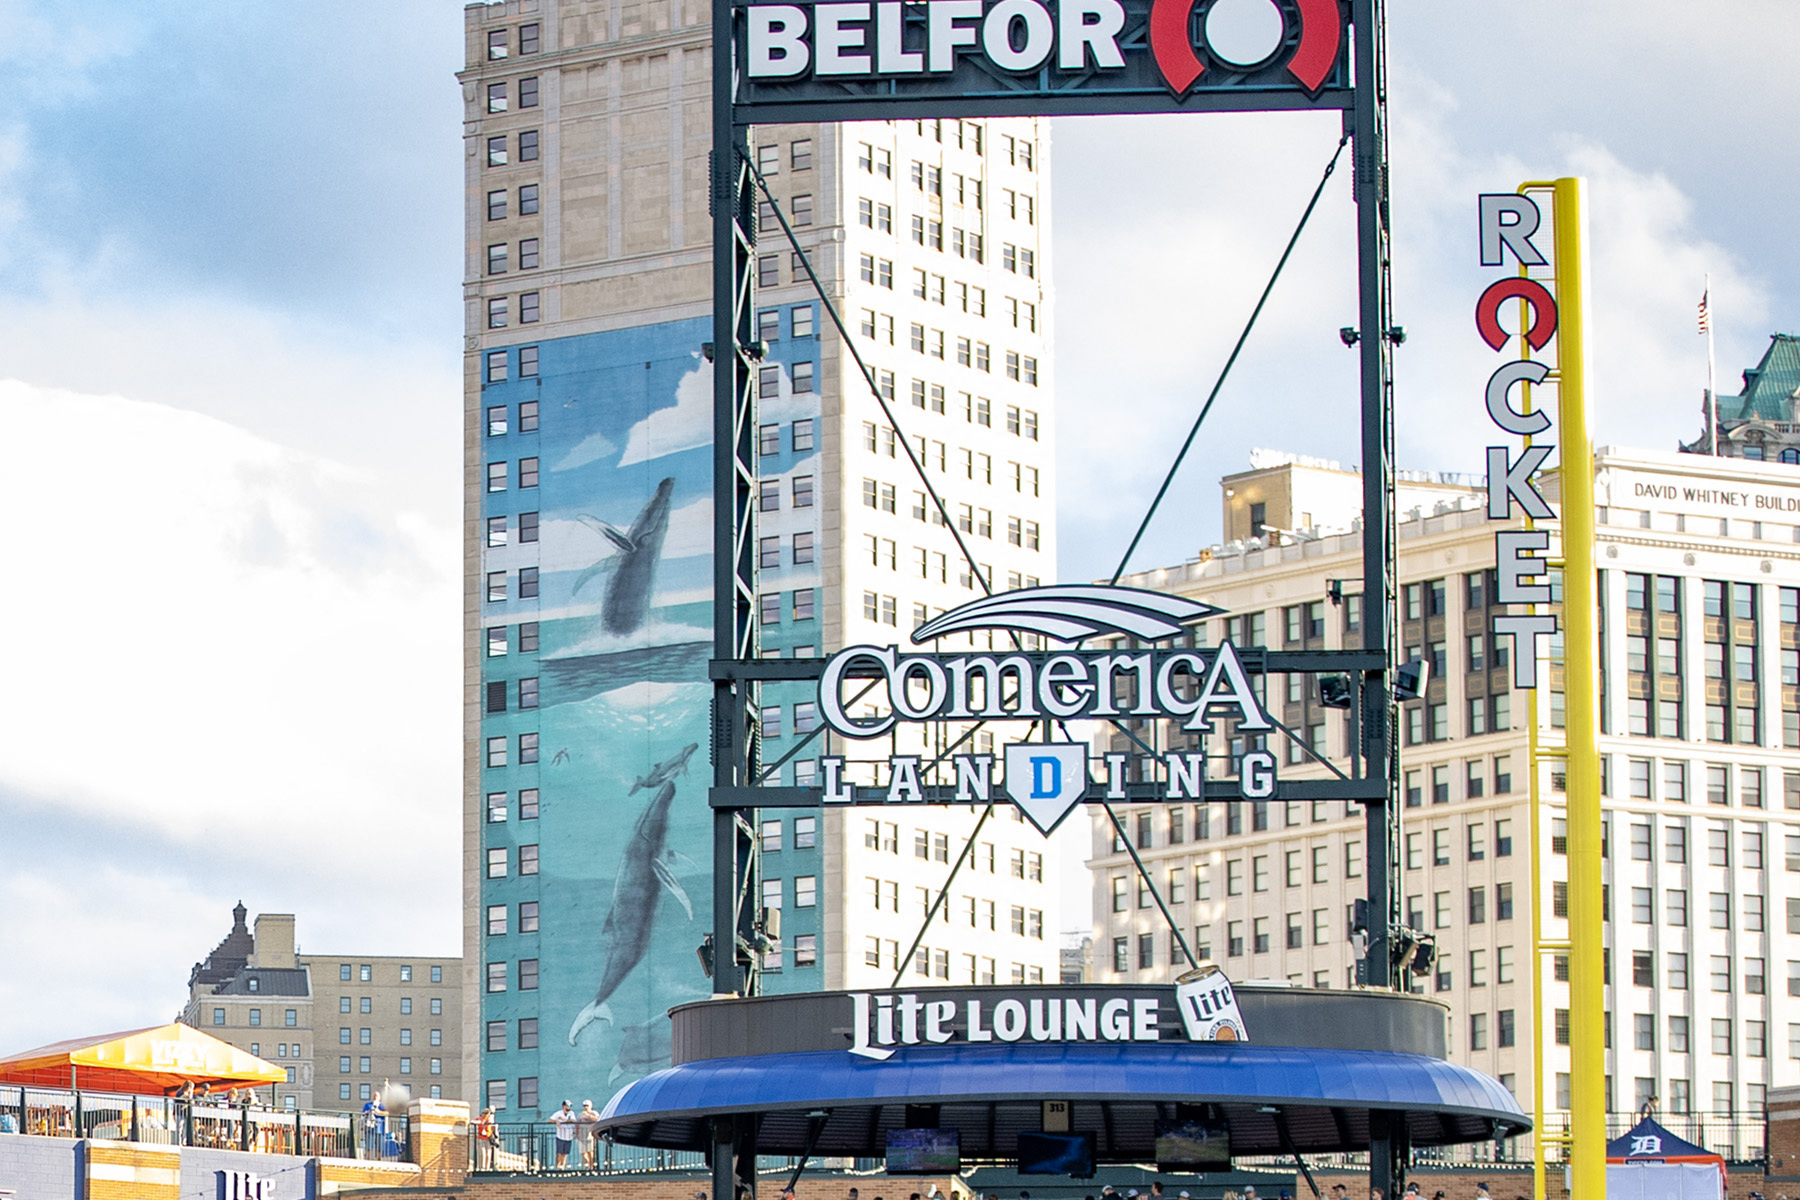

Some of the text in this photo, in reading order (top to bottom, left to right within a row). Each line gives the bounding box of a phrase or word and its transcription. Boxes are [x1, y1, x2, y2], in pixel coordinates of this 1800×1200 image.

[745, 0, 1128, 79] BELFOR
[1475, 193, 1558, 689] ROCKET
[1634, 483, 1678, 500] DAVID
[1682, 487, 1749, 507] WHITNEY
[821, 753, 1277, 803] LANDING
[847, 993, 1160, 1061] Lite LOUNGE
[1187, 986, 1232, 1022] Lite
[1049, 1102, 1066, 1114] 313
